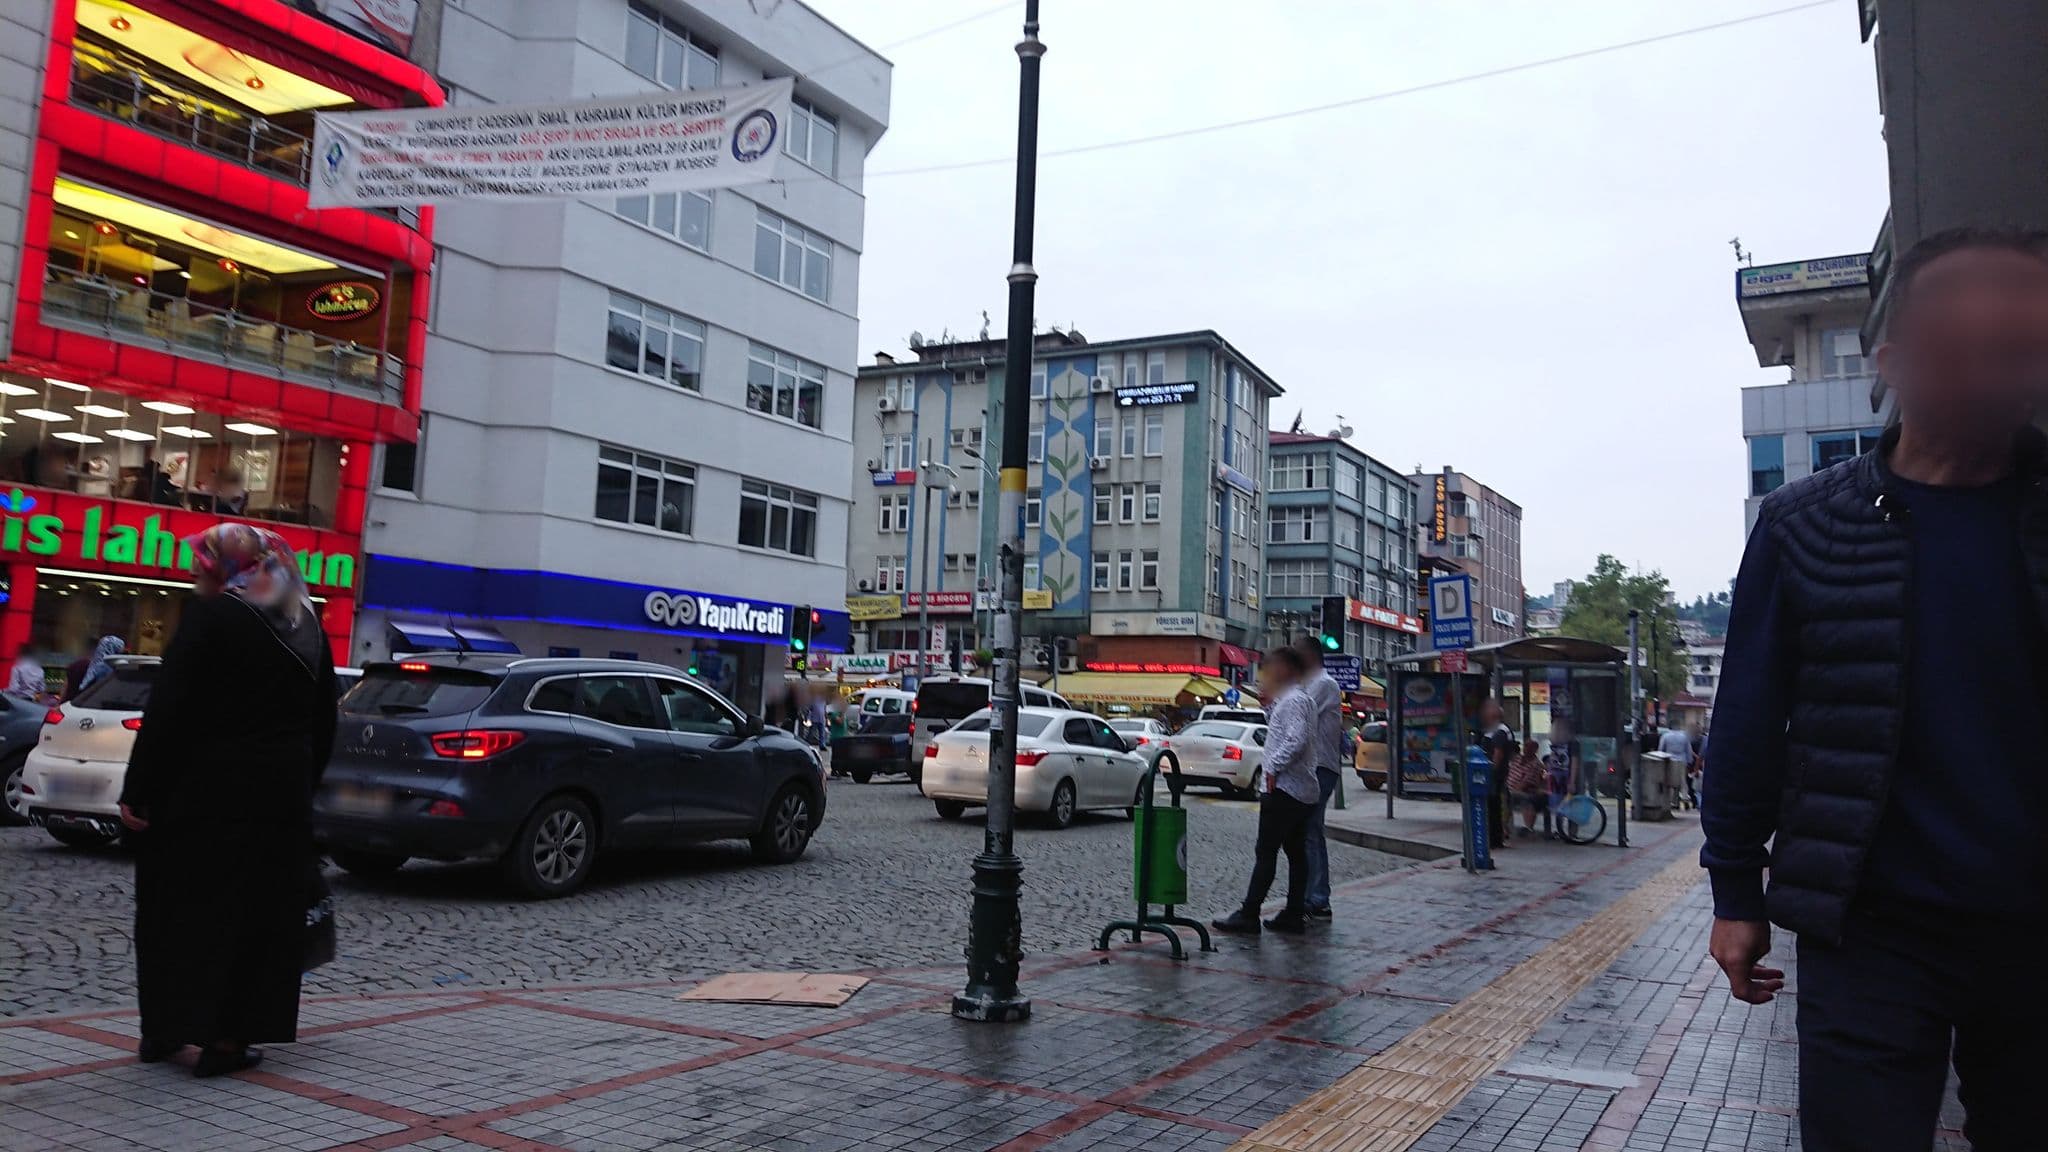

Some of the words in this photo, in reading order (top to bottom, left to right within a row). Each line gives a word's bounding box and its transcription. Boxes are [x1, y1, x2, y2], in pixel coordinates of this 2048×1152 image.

[574, 106, 632, 123] KAHRAMAN
[636, 101, 677, 119] KÜLTÜR
[679, 96, 726, 115] MERKEZİ
[81, 505, 355, 589] lahun
[698, 597, 784, 635] YapıKredi
[1441, 586, 1459, 614] D
